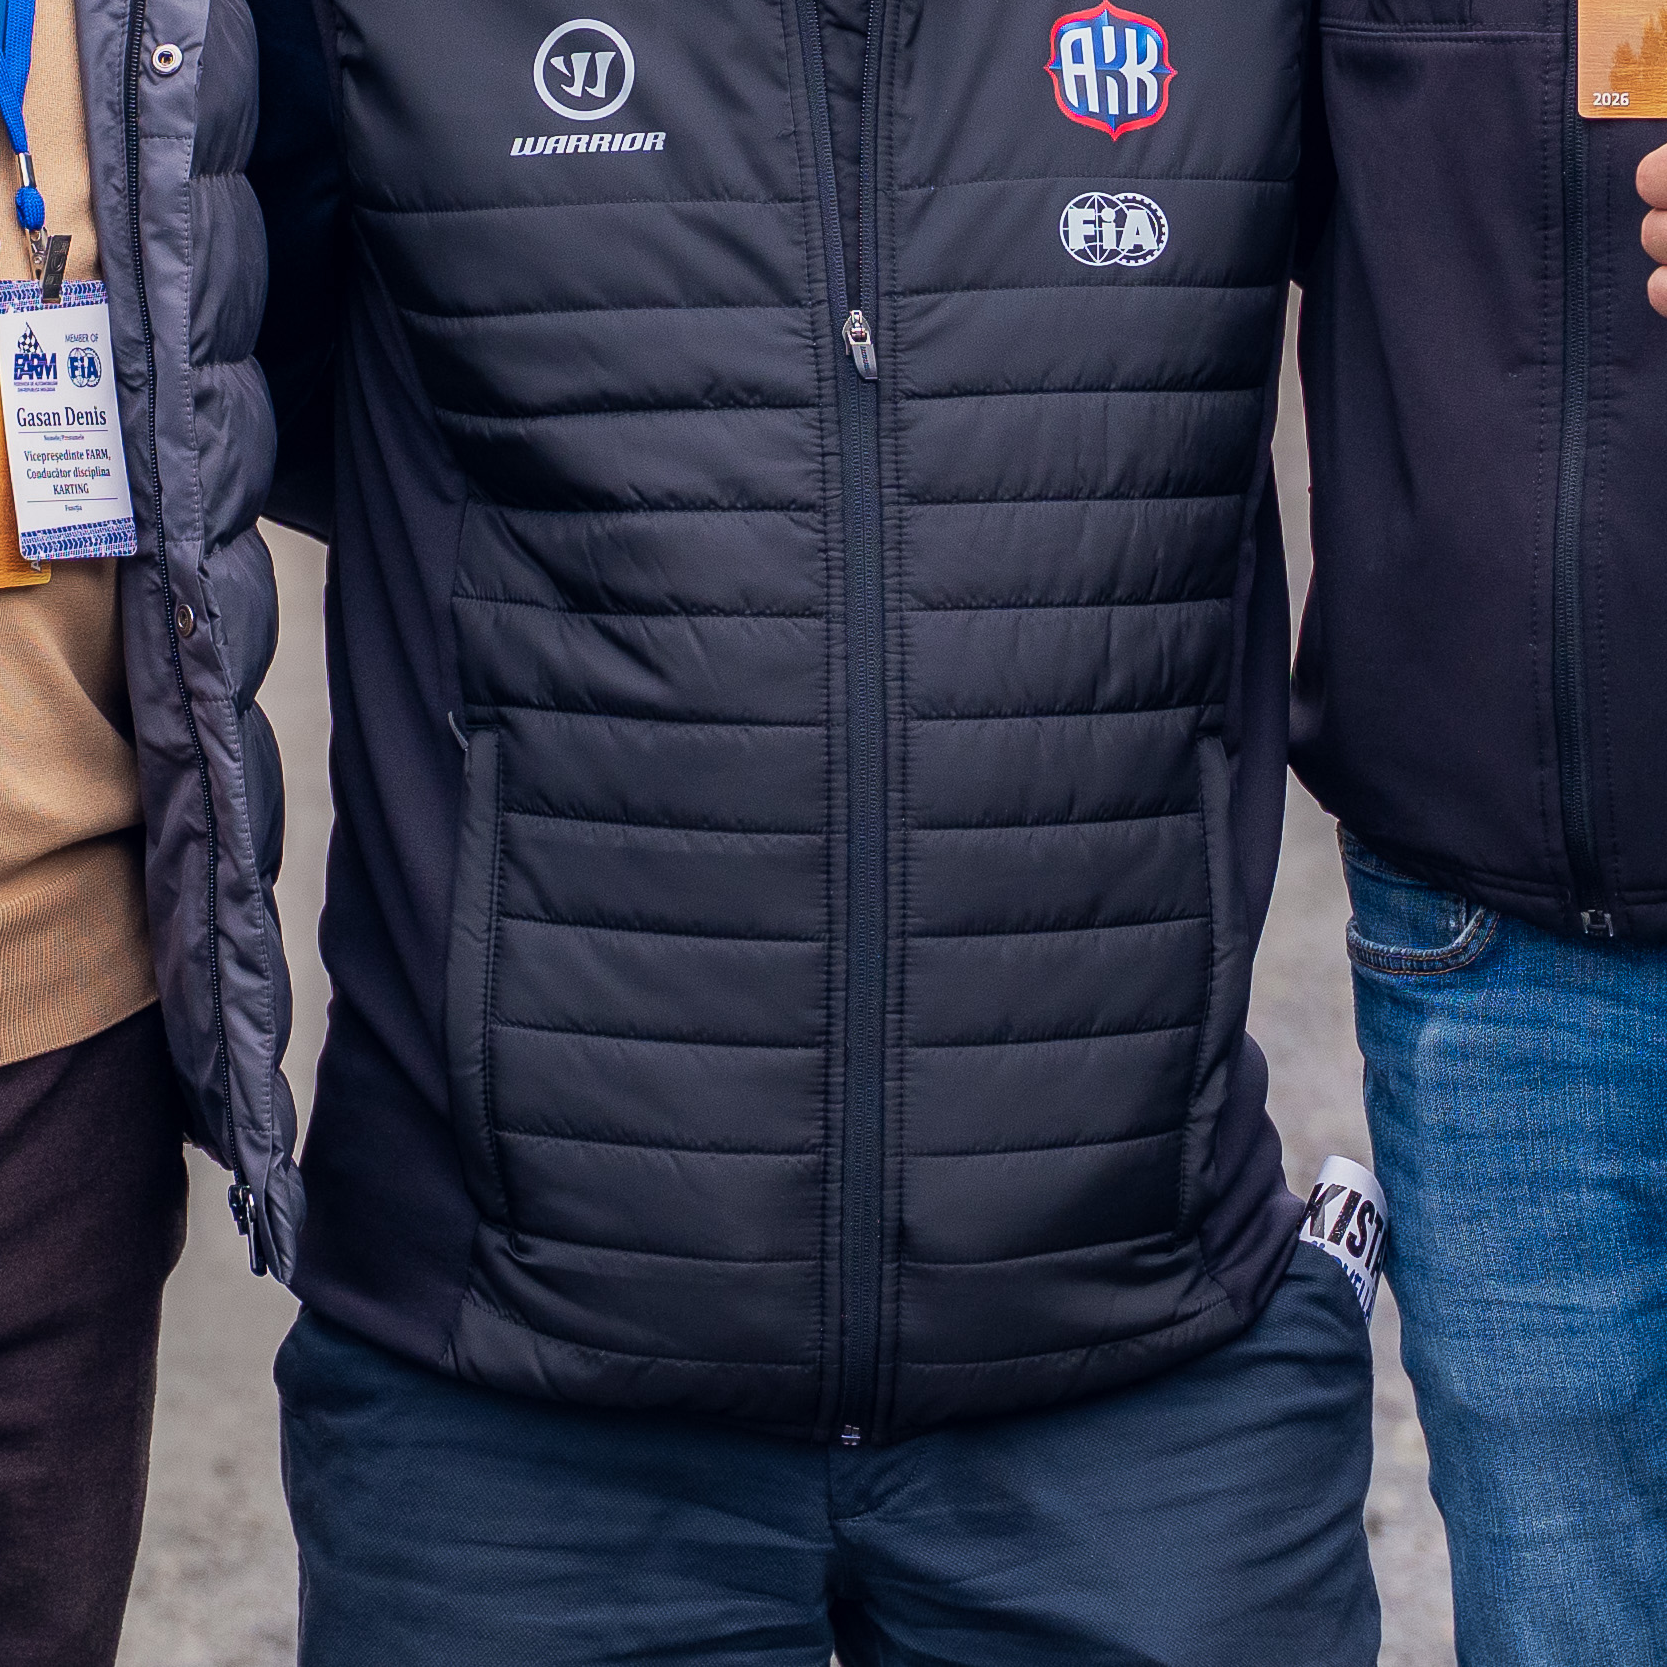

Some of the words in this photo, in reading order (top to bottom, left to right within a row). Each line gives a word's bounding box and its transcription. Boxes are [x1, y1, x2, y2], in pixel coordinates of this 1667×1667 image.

[1058, 25, 1159, 114] AKK
[1592, 92, 1630, 106] 2026
[510, 132, 667, 156] WARRIOR
[65, 334, 89, 343] MEMBER
[90, 333, 99, 343] OF
[17, 407, 62, 427] Gasan
[64, 405, 107, 426] Denis
[53, 482, 90, 495] KARTING
